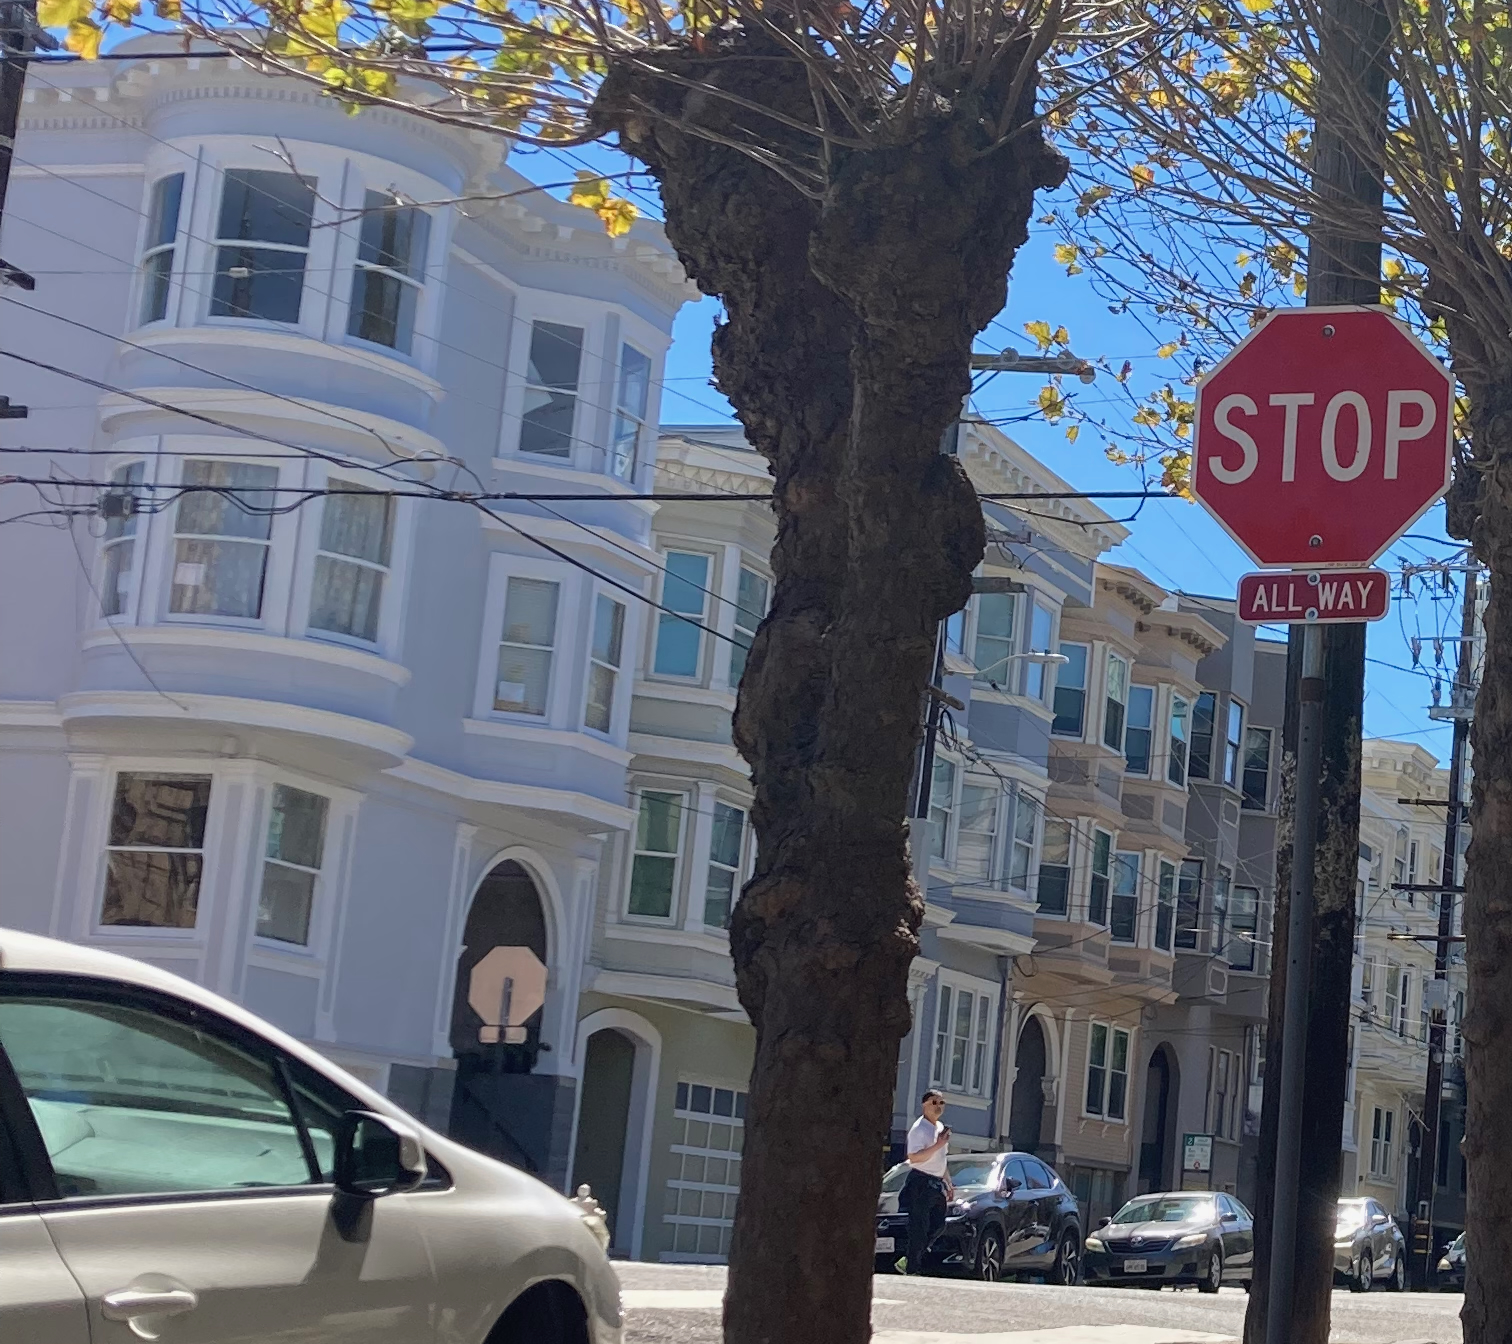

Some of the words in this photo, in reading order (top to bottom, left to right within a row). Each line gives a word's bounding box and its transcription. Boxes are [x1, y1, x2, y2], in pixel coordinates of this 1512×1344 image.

[1208, 390, 1437, 485] STOP
[1252, 584, 1303, 613] ALL
[1318, 580, 1374, 612] WAY
